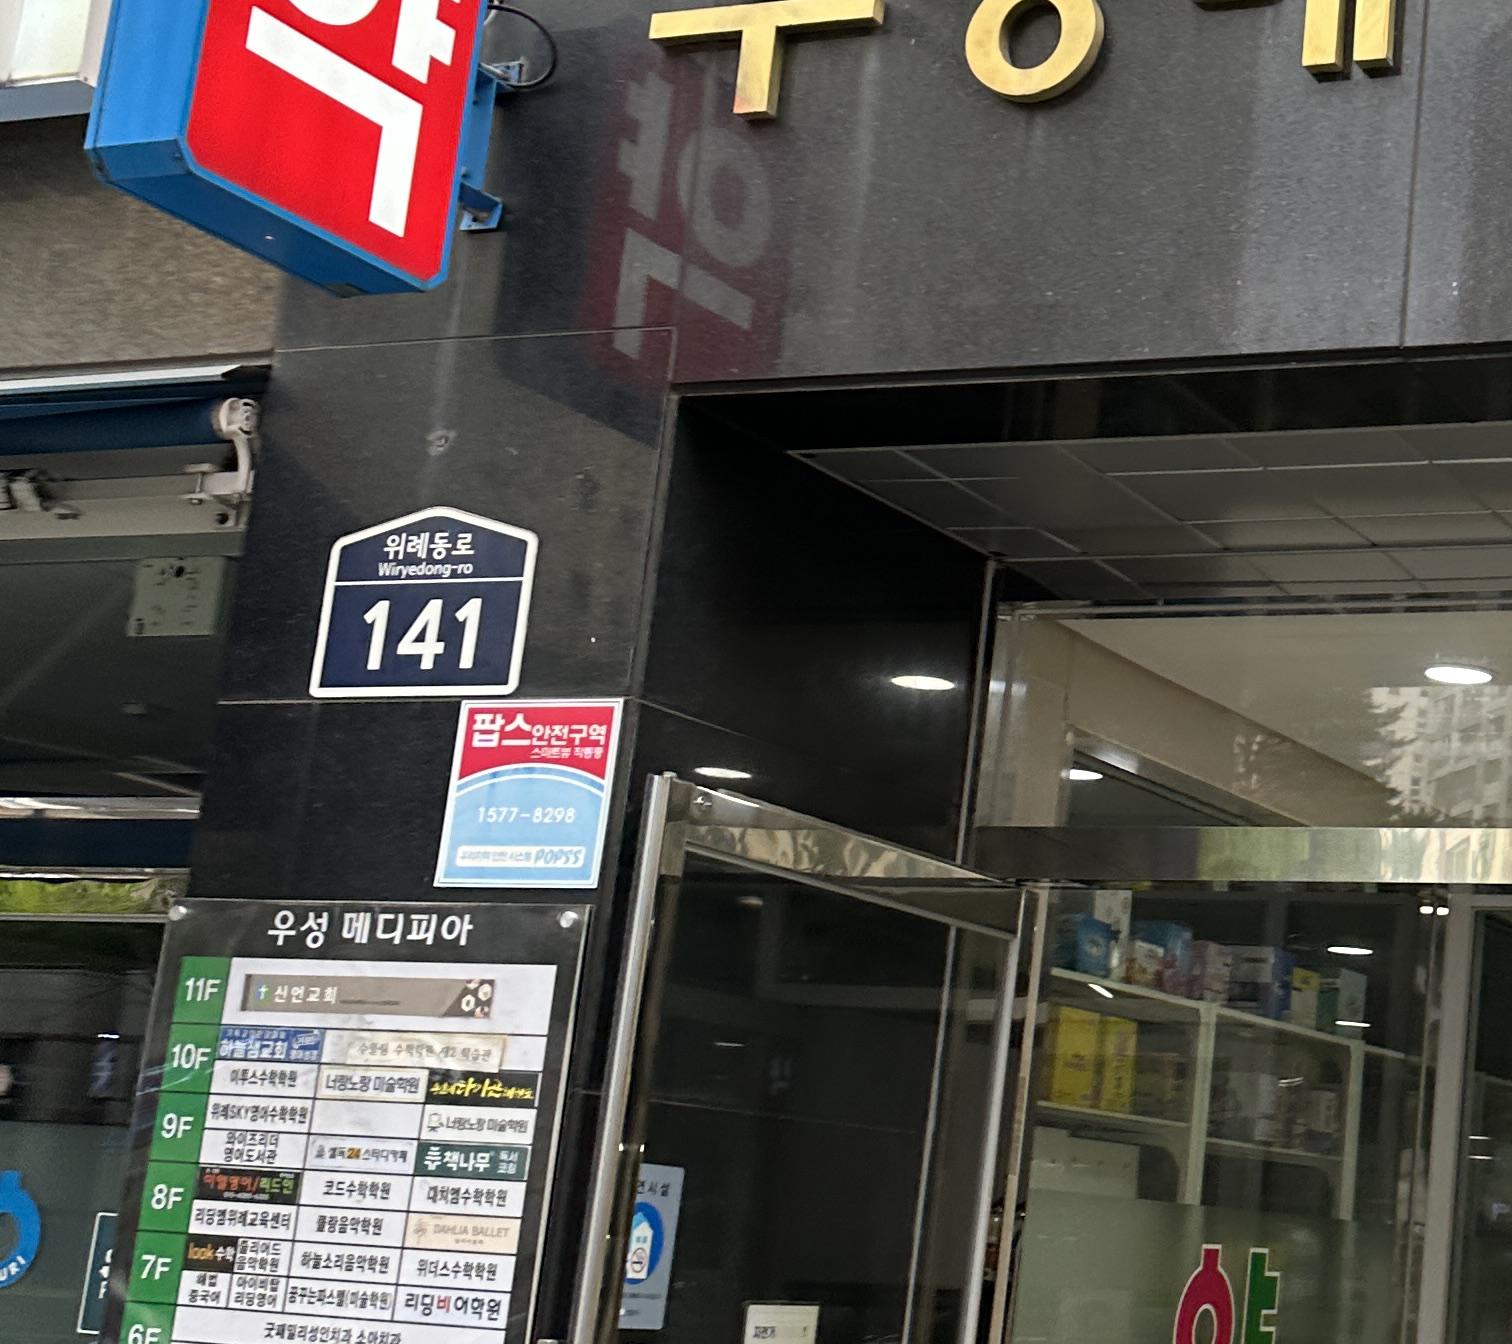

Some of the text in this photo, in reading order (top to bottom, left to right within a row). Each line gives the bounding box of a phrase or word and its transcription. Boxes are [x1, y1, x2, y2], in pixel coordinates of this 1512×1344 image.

[384, 532, 474, 560] 위례동로
[379, 561, 473, 577] Wiryedong-ro
[363, 598, 482, 670] 141
[478, 807, 576, 824] 1577-8298
[534, 848, 582, 865] POPSS
[268, 910, 472, 948] 우성 메디피아
[185, 978, 222, 1002] 11F
[171, 1044, 211, 1069] 10F
[326, 1075, 372, 1092] 너랑노랑
[374, 1077, 419, 1093] 미술학원
[162, 1113, 194, 1139] 9F
[444, 1151, 490, 1172] 책나무
[151, 1184, 184, 1209] 8F
[323, 1181, 391, 1200] 코드수학학원
[434, 1224, 510, 1238] DAHLIA BALLET
[141, 1255, 172, 1280] 7F
[417, 1259, 498, 1282] 위더스수학학원
